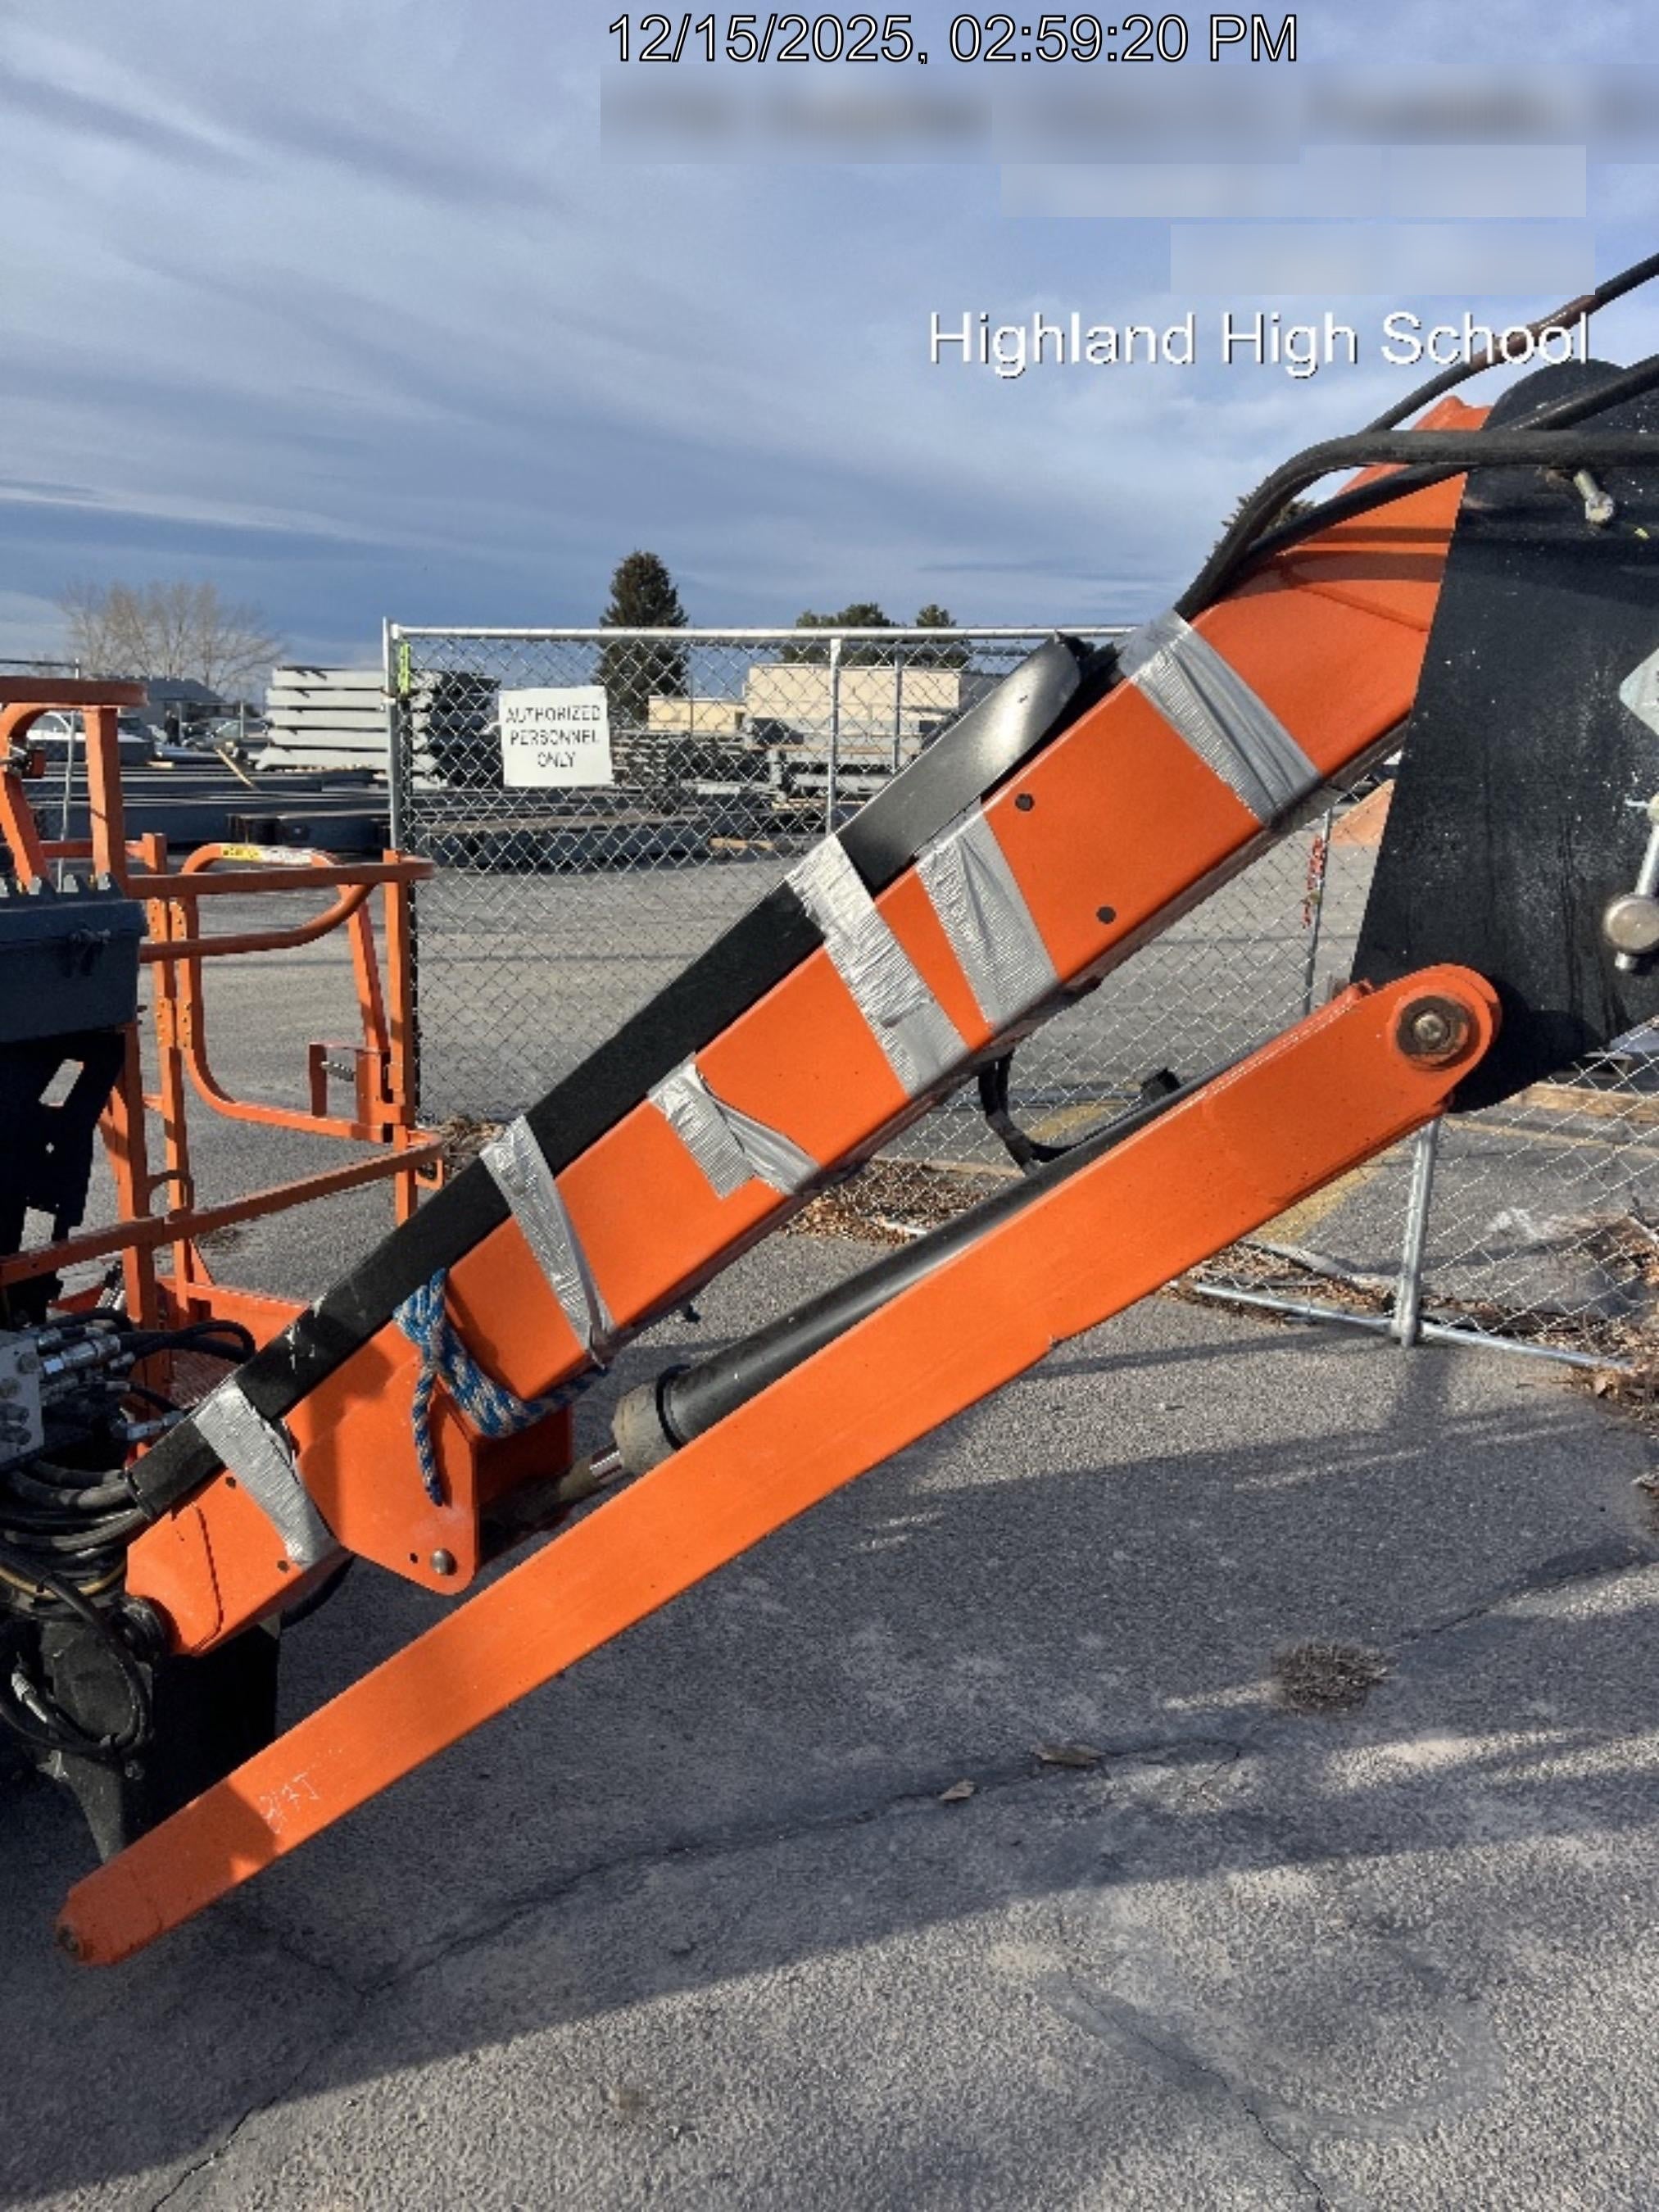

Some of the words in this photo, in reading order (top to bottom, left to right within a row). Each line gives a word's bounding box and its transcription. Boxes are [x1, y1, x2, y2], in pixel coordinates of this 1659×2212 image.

[505, 705, 601, 723] AUTHORIZED
[510, 729, 600, 746] PERSONNEL
[537, 751, 576, 768] ONLY
